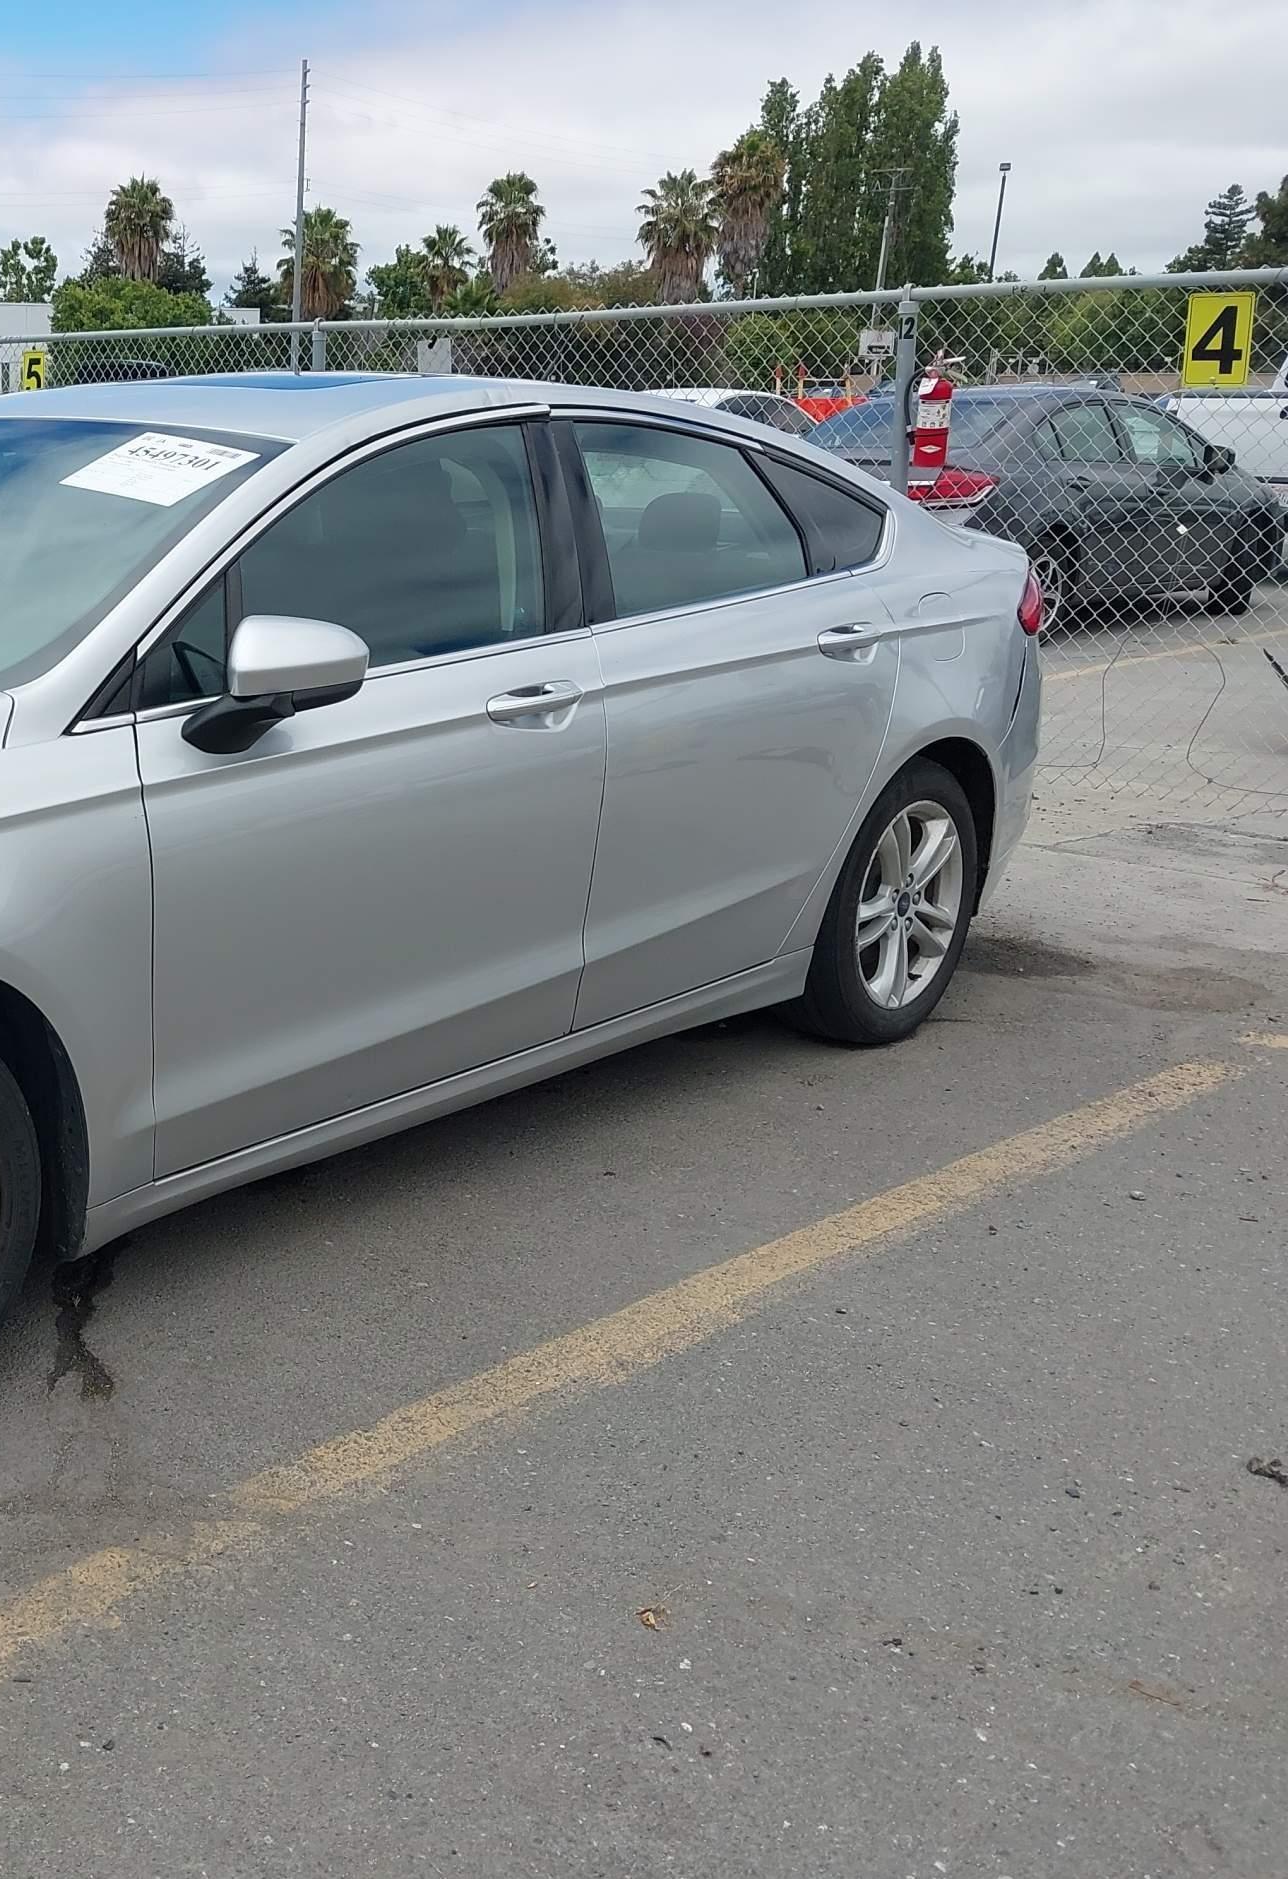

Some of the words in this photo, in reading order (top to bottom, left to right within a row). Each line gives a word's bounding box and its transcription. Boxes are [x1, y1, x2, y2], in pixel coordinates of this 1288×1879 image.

[898, 316, 916, 340] 12
[1191, 305, 1243, 375] 4
[26, 357, 42, 391] 5
[127, 445, 222, 471] 45497301
